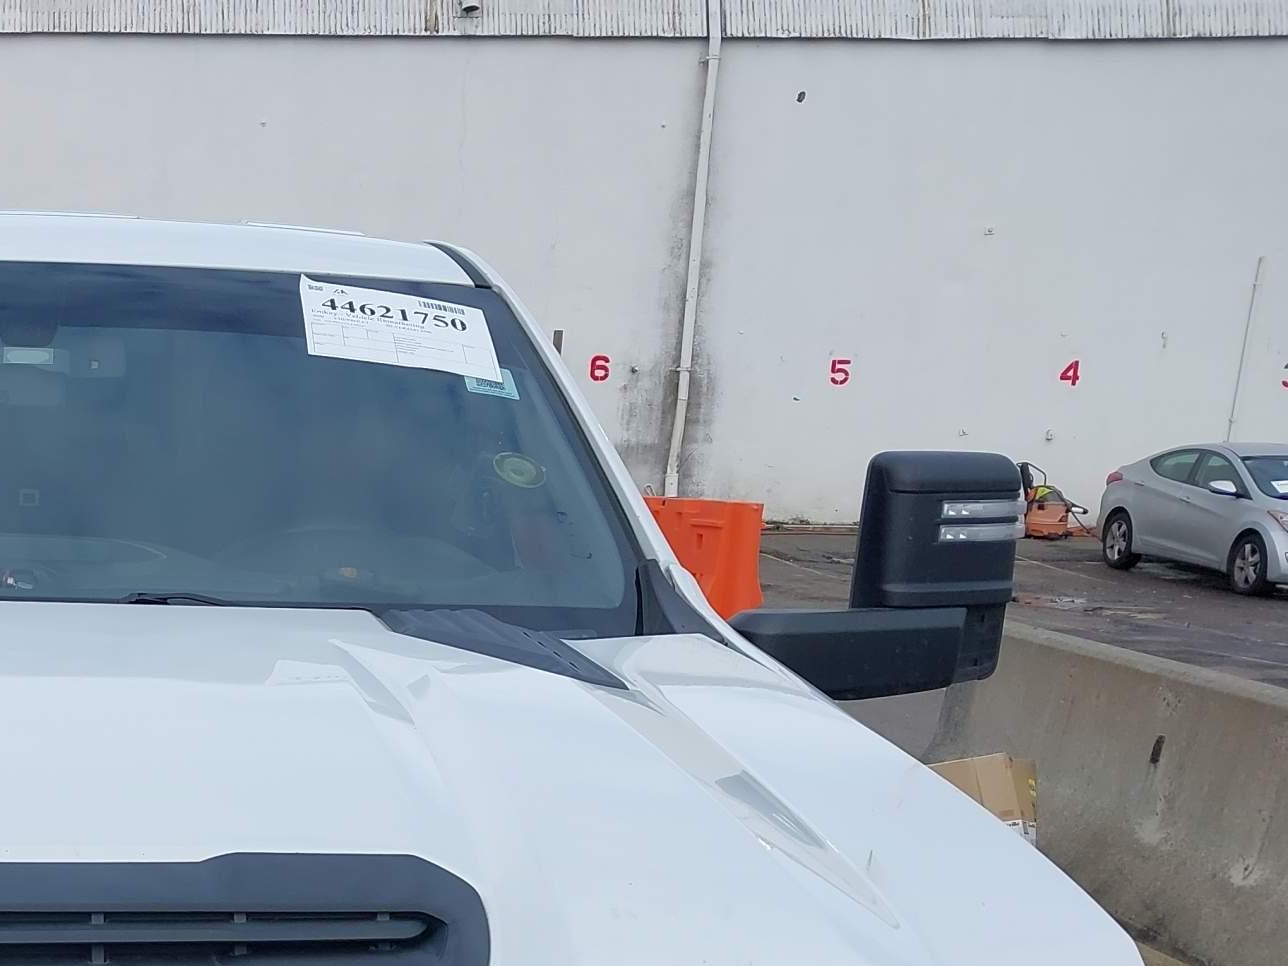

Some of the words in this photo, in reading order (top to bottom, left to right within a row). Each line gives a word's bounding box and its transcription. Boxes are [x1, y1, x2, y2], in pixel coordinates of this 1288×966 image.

[321, 298, 467, 332] 44621750
[588, 354, 610, 382] 6
[830, 358, 850, 385] 5
[1058, 361, 1080, 385] 4
